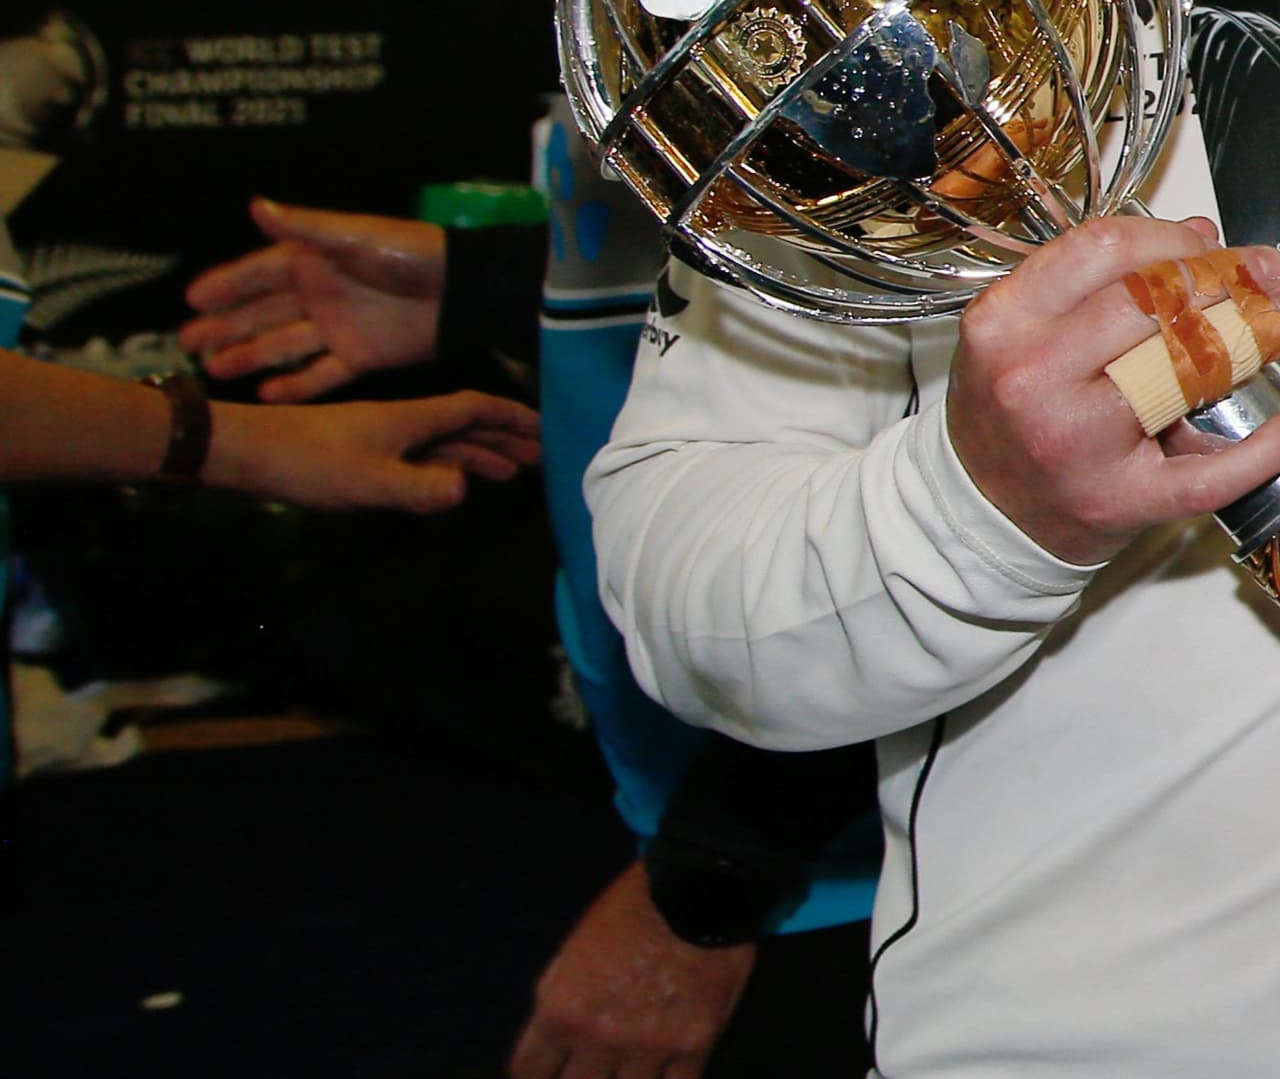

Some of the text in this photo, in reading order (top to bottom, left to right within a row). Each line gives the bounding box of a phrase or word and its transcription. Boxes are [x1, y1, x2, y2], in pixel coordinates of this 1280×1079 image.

[184, 35, 304, 64] WORLD
[311, 33, 382, 61] TEST
[124, 65, 385, 96] CHAMPIONSHIP
[125, 98, 306, 128] FINAL 2021
